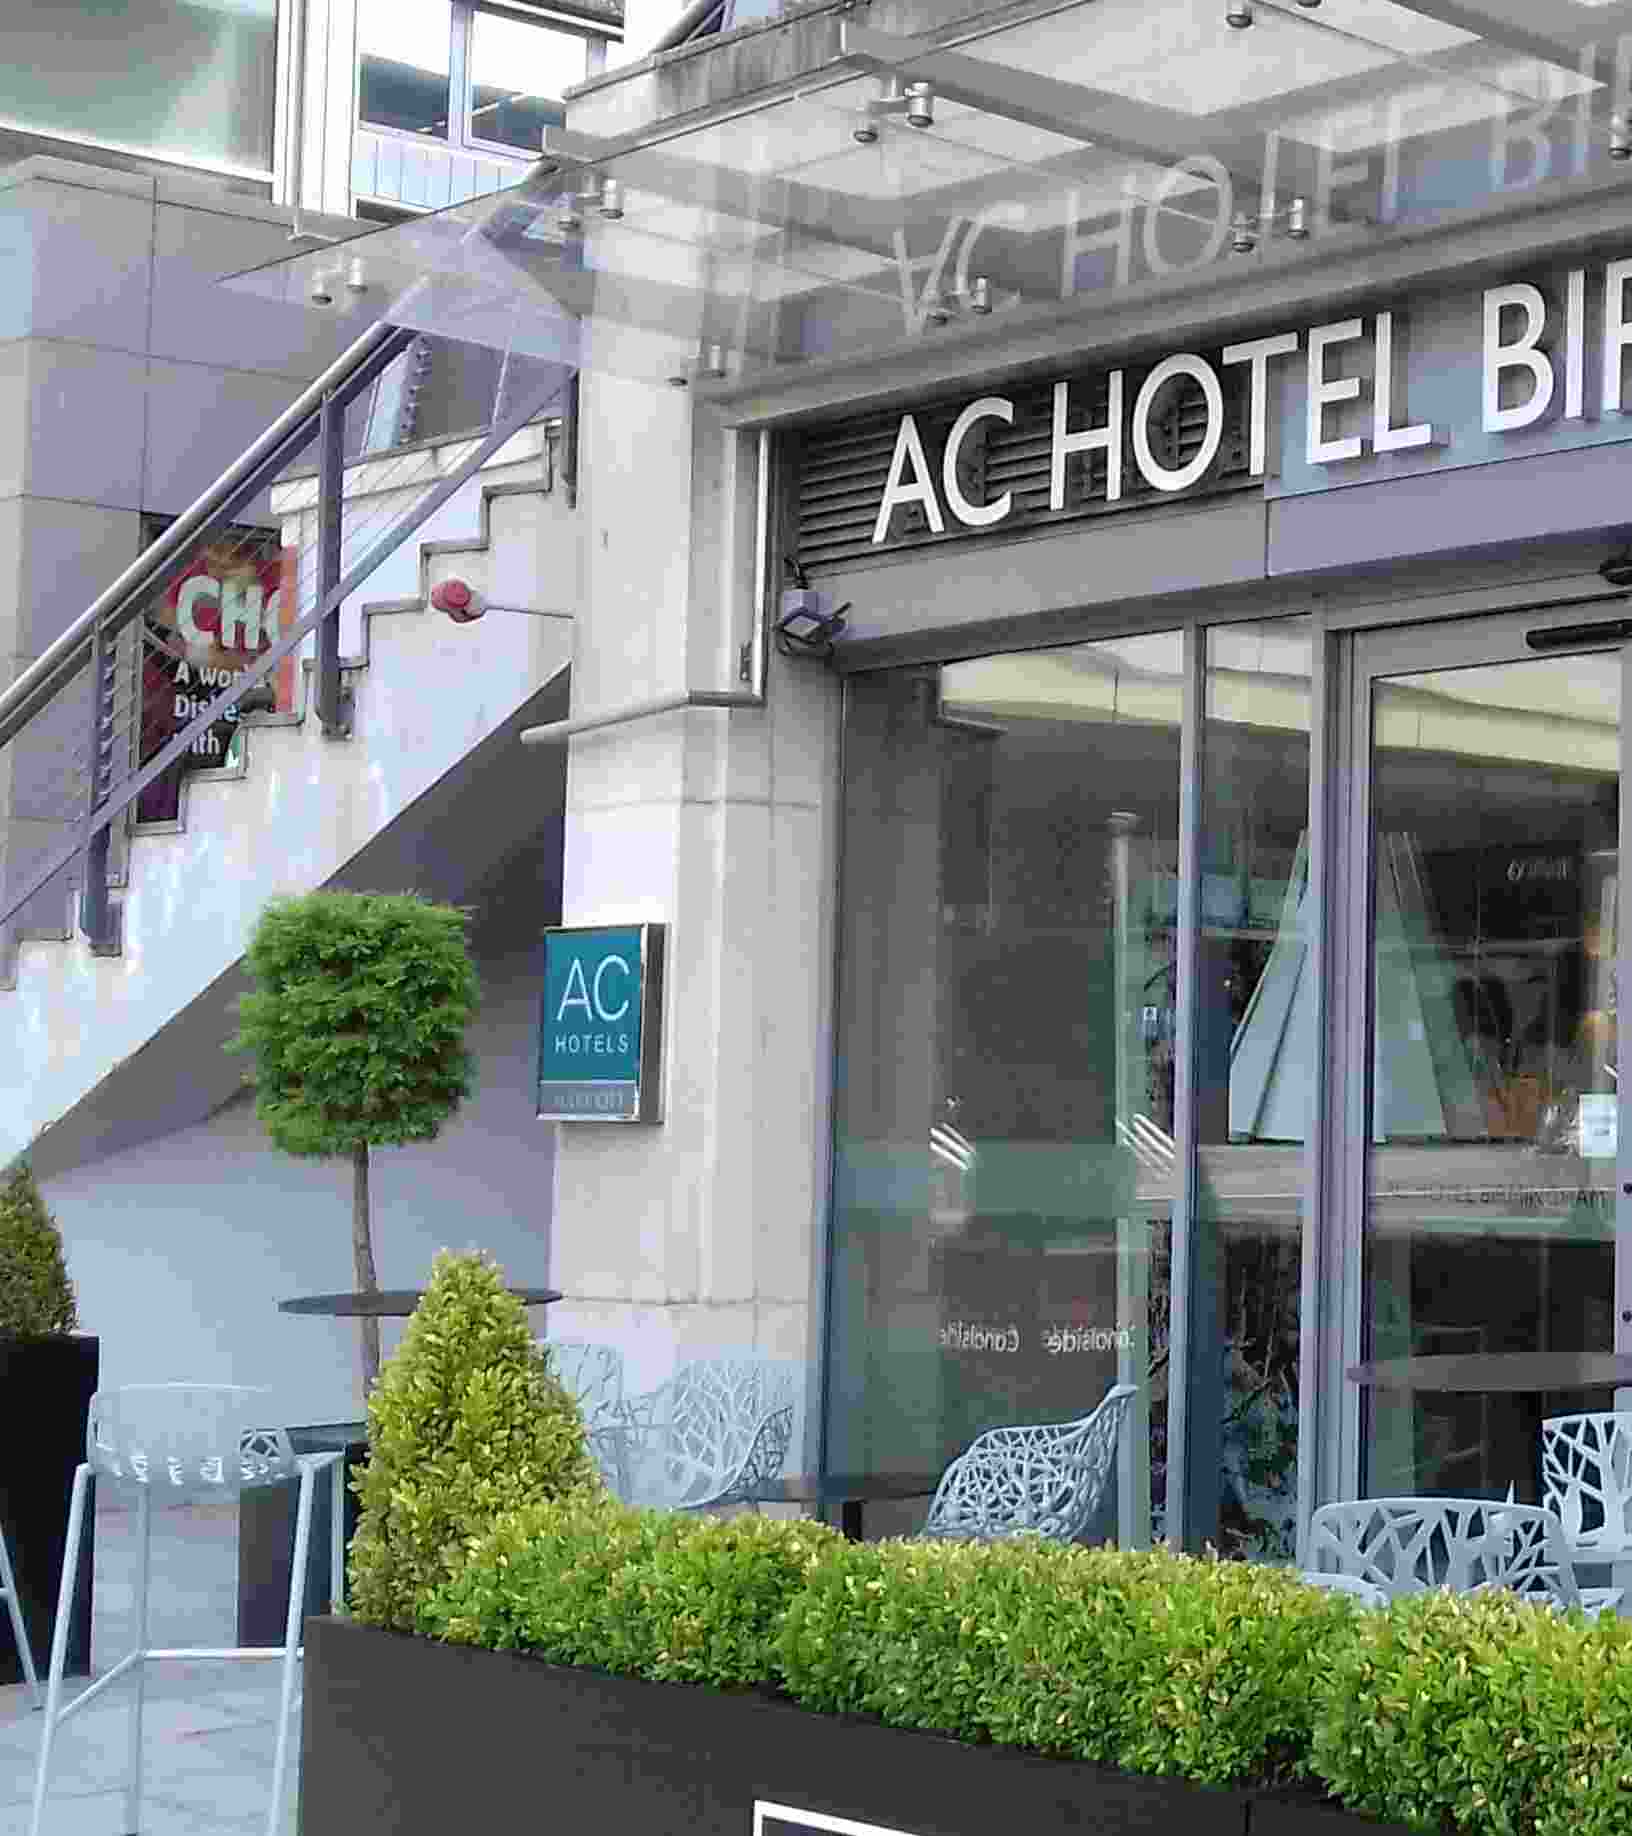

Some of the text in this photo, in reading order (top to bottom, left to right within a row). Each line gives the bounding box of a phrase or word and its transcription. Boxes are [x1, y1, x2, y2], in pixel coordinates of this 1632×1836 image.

[871, 397, 1014, 545] AC
[1049, 311, 1432, 512] HOTEL
[174, 660, 190, 684] A
[556, 954, 631, 1022] AC
[554, 1033, 630, 1054] HOTELS
